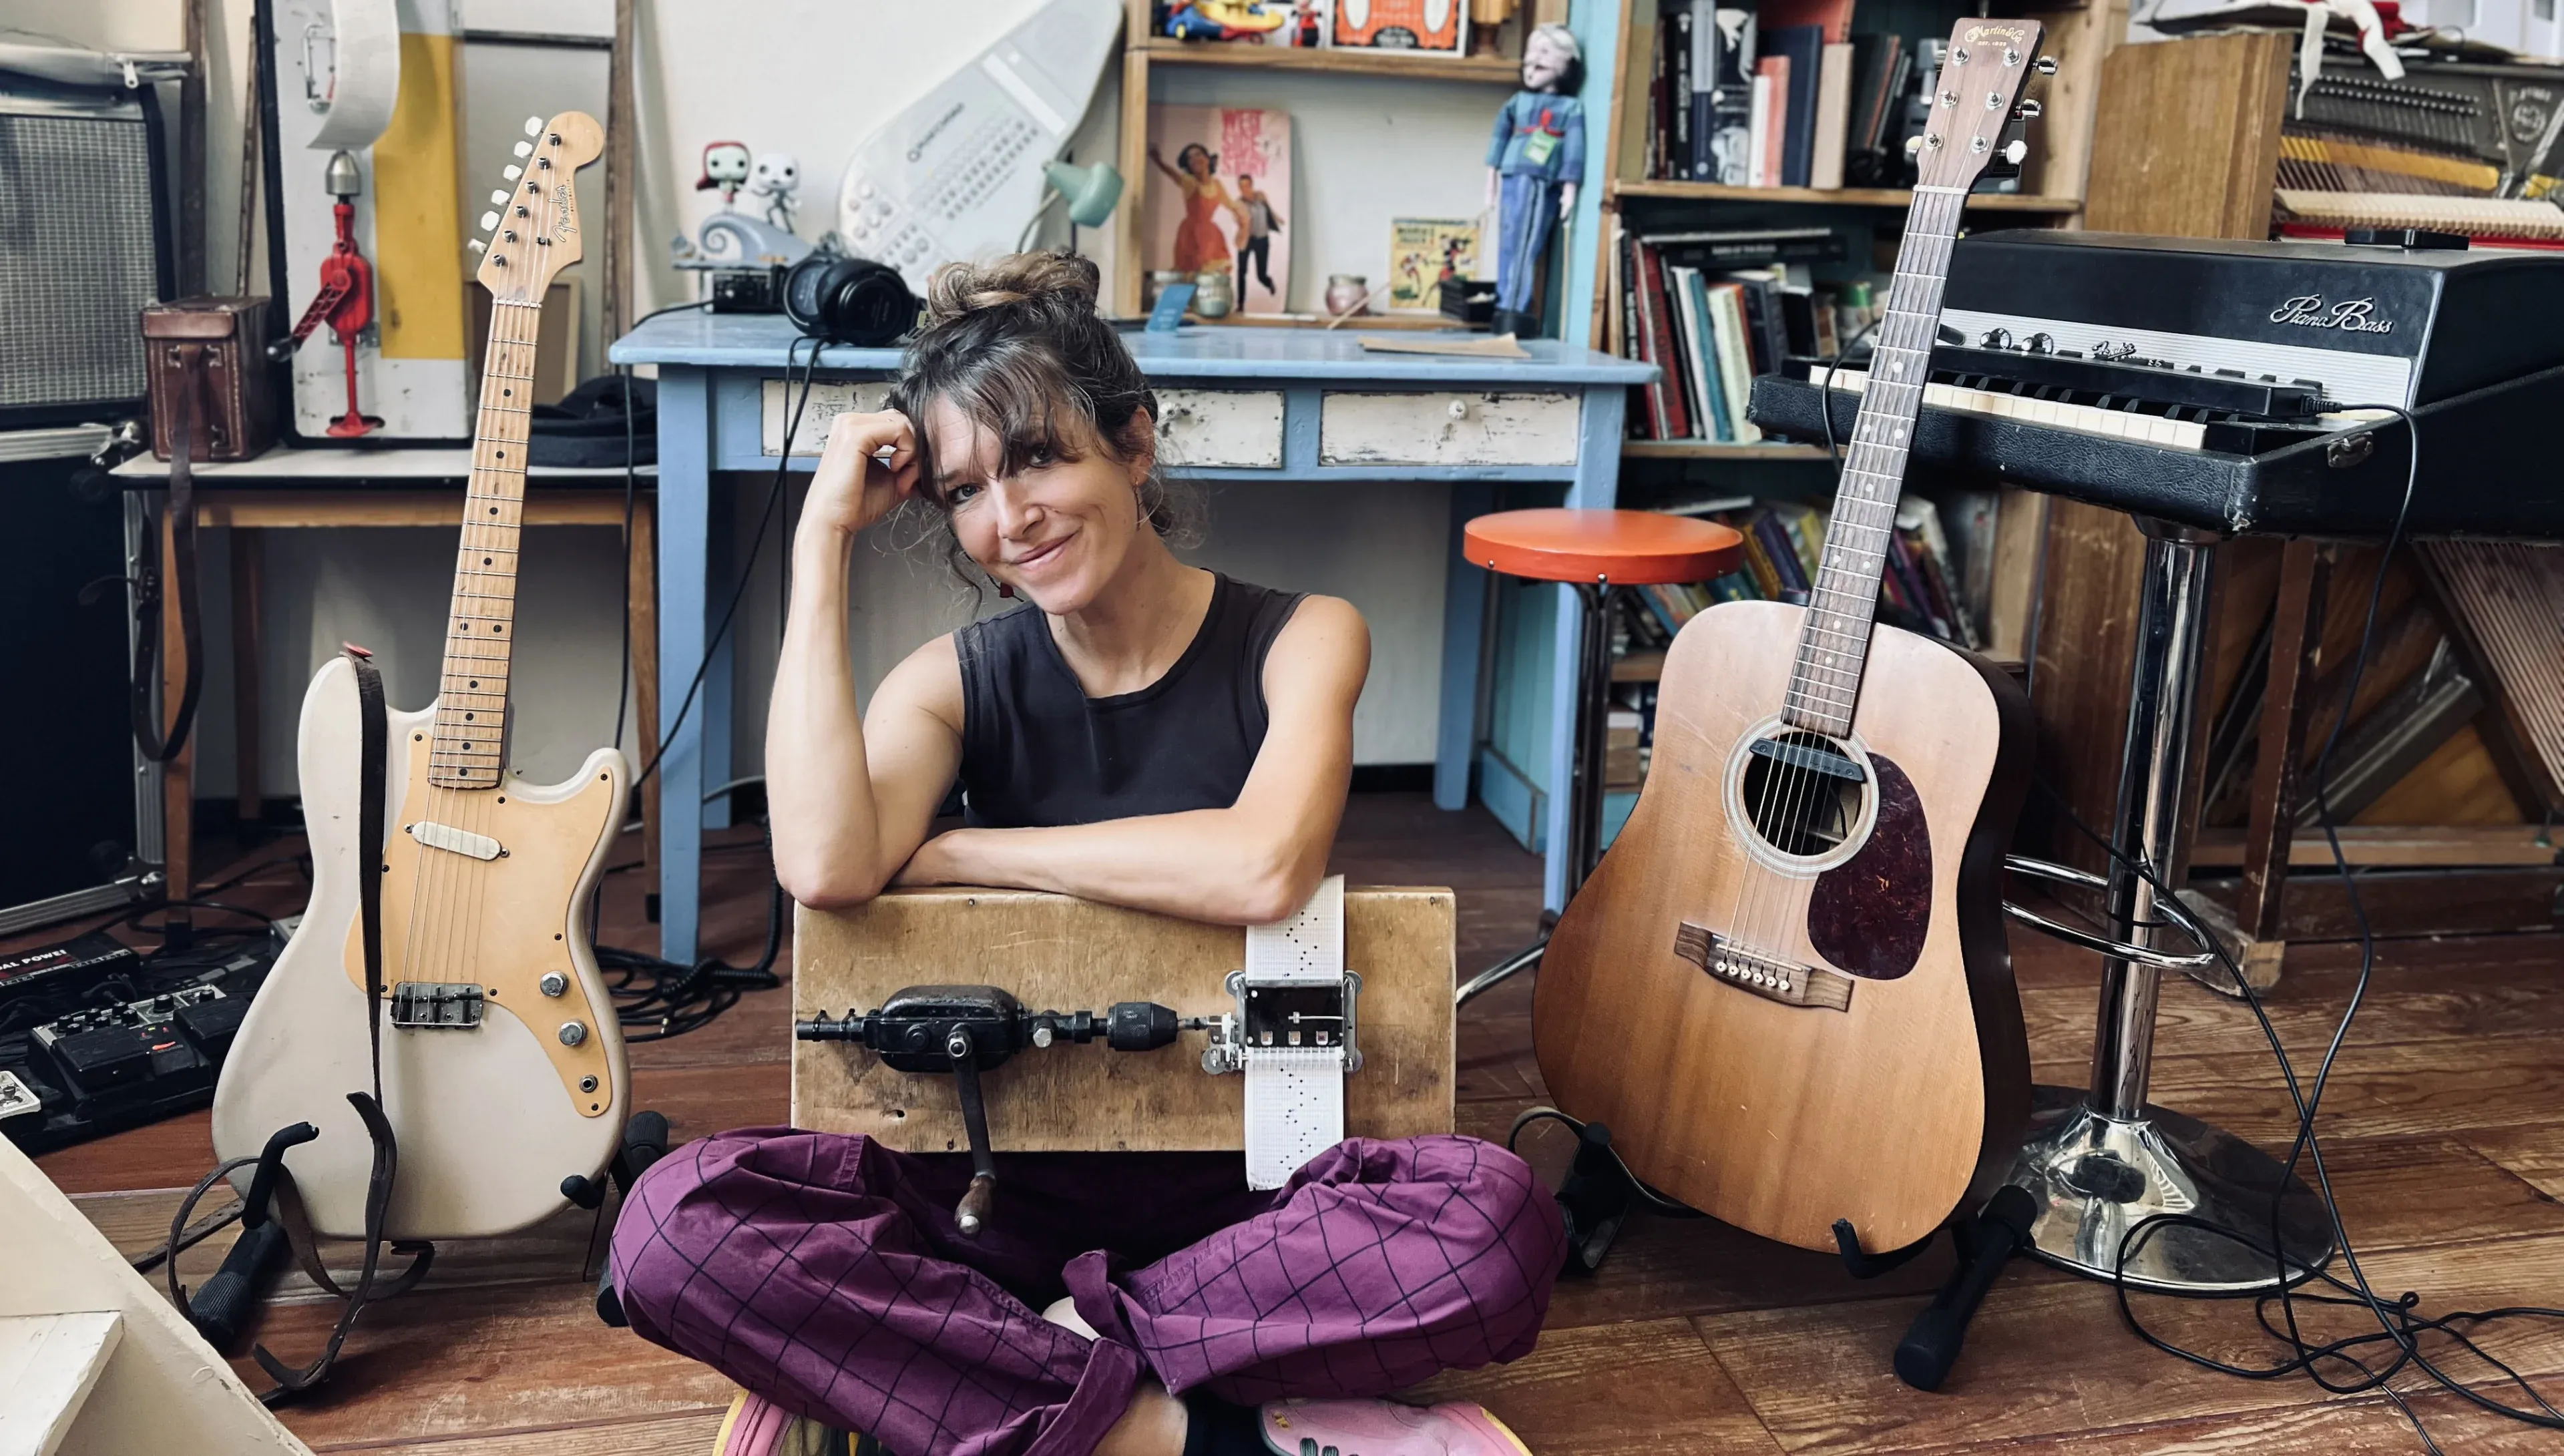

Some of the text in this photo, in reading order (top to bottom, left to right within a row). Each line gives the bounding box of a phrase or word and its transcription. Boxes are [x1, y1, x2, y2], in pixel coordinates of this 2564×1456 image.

[547, 184, 578, 242] Fender
[2270, 294, 2392, 333] Piano Bass
